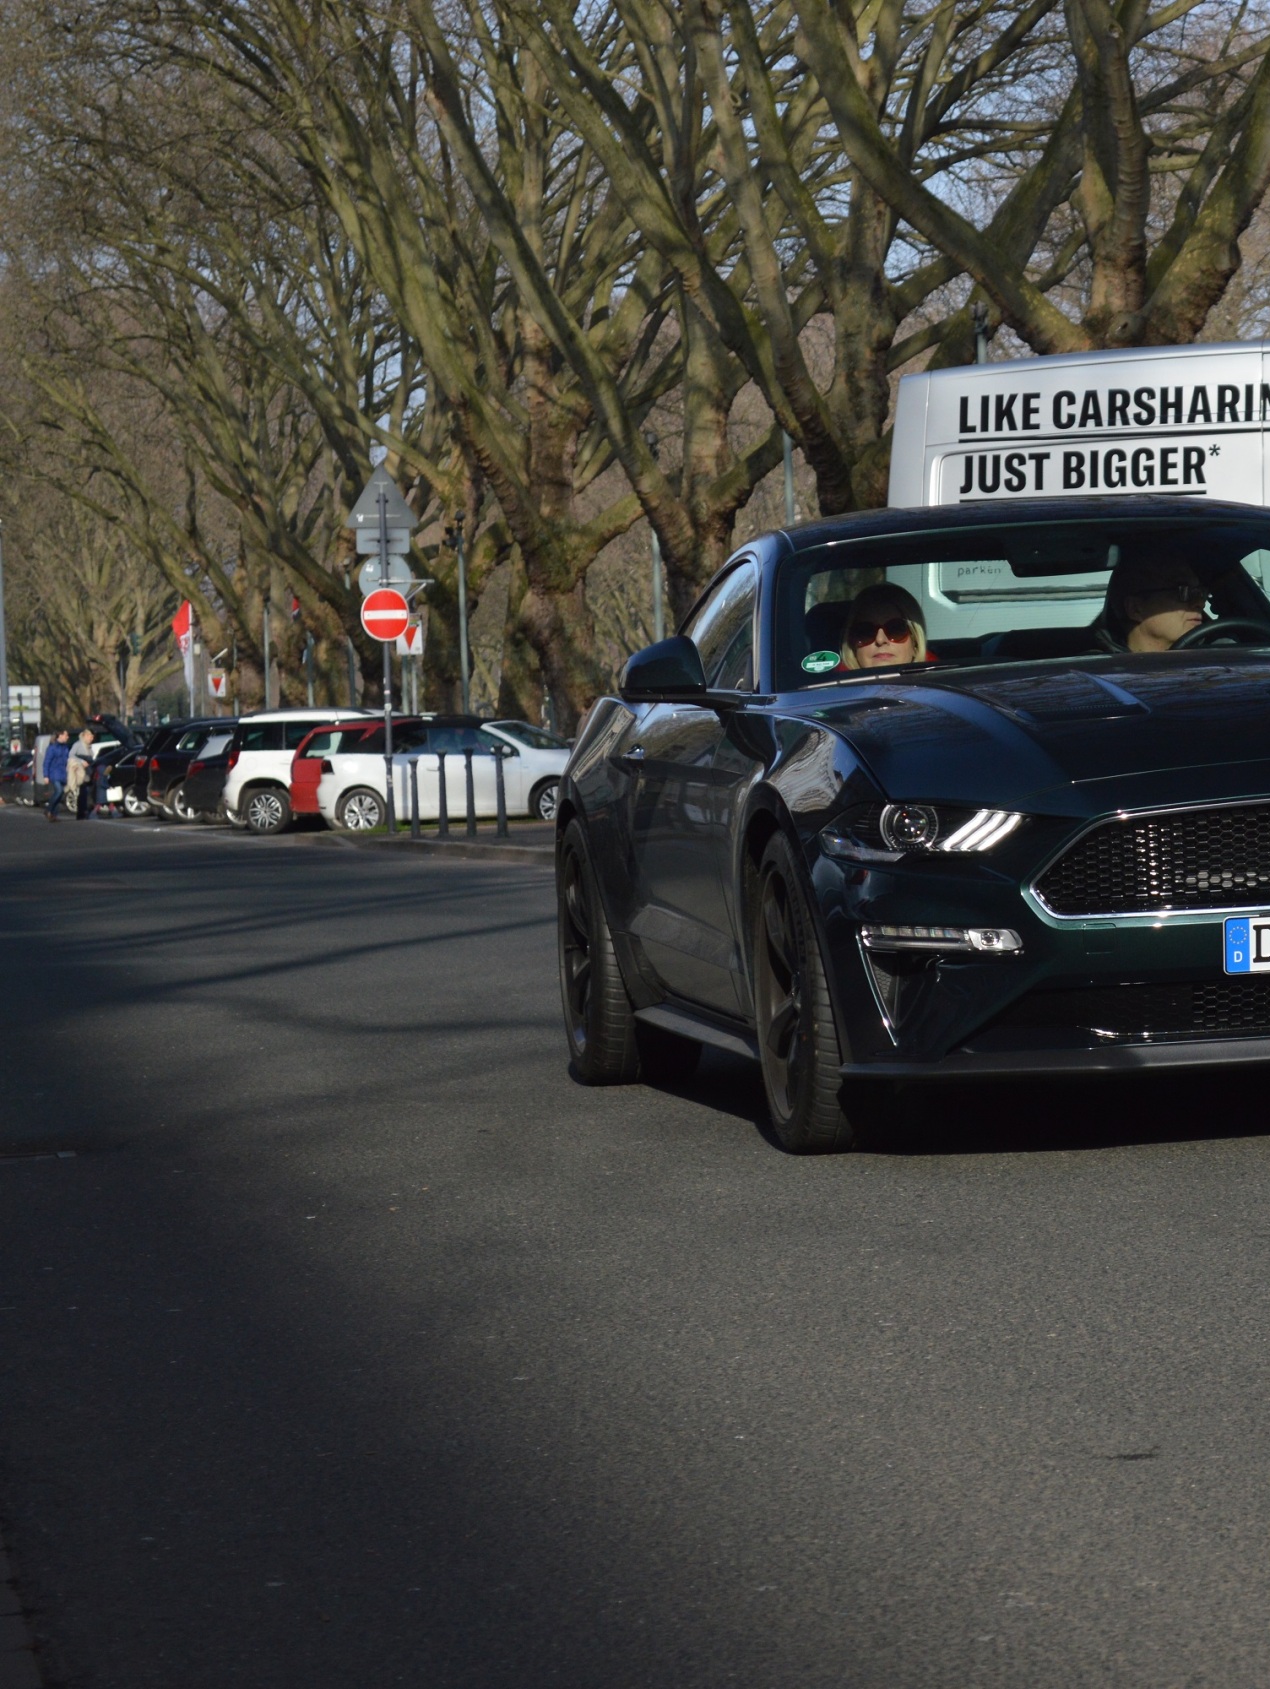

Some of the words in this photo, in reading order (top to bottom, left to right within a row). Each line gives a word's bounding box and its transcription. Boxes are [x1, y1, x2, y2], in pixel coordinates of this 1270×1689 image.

[960, 393, 1041, 433] LIKE
[960, 452, 1051, 494] JUST
[1234, 951, 1242, 963] D
